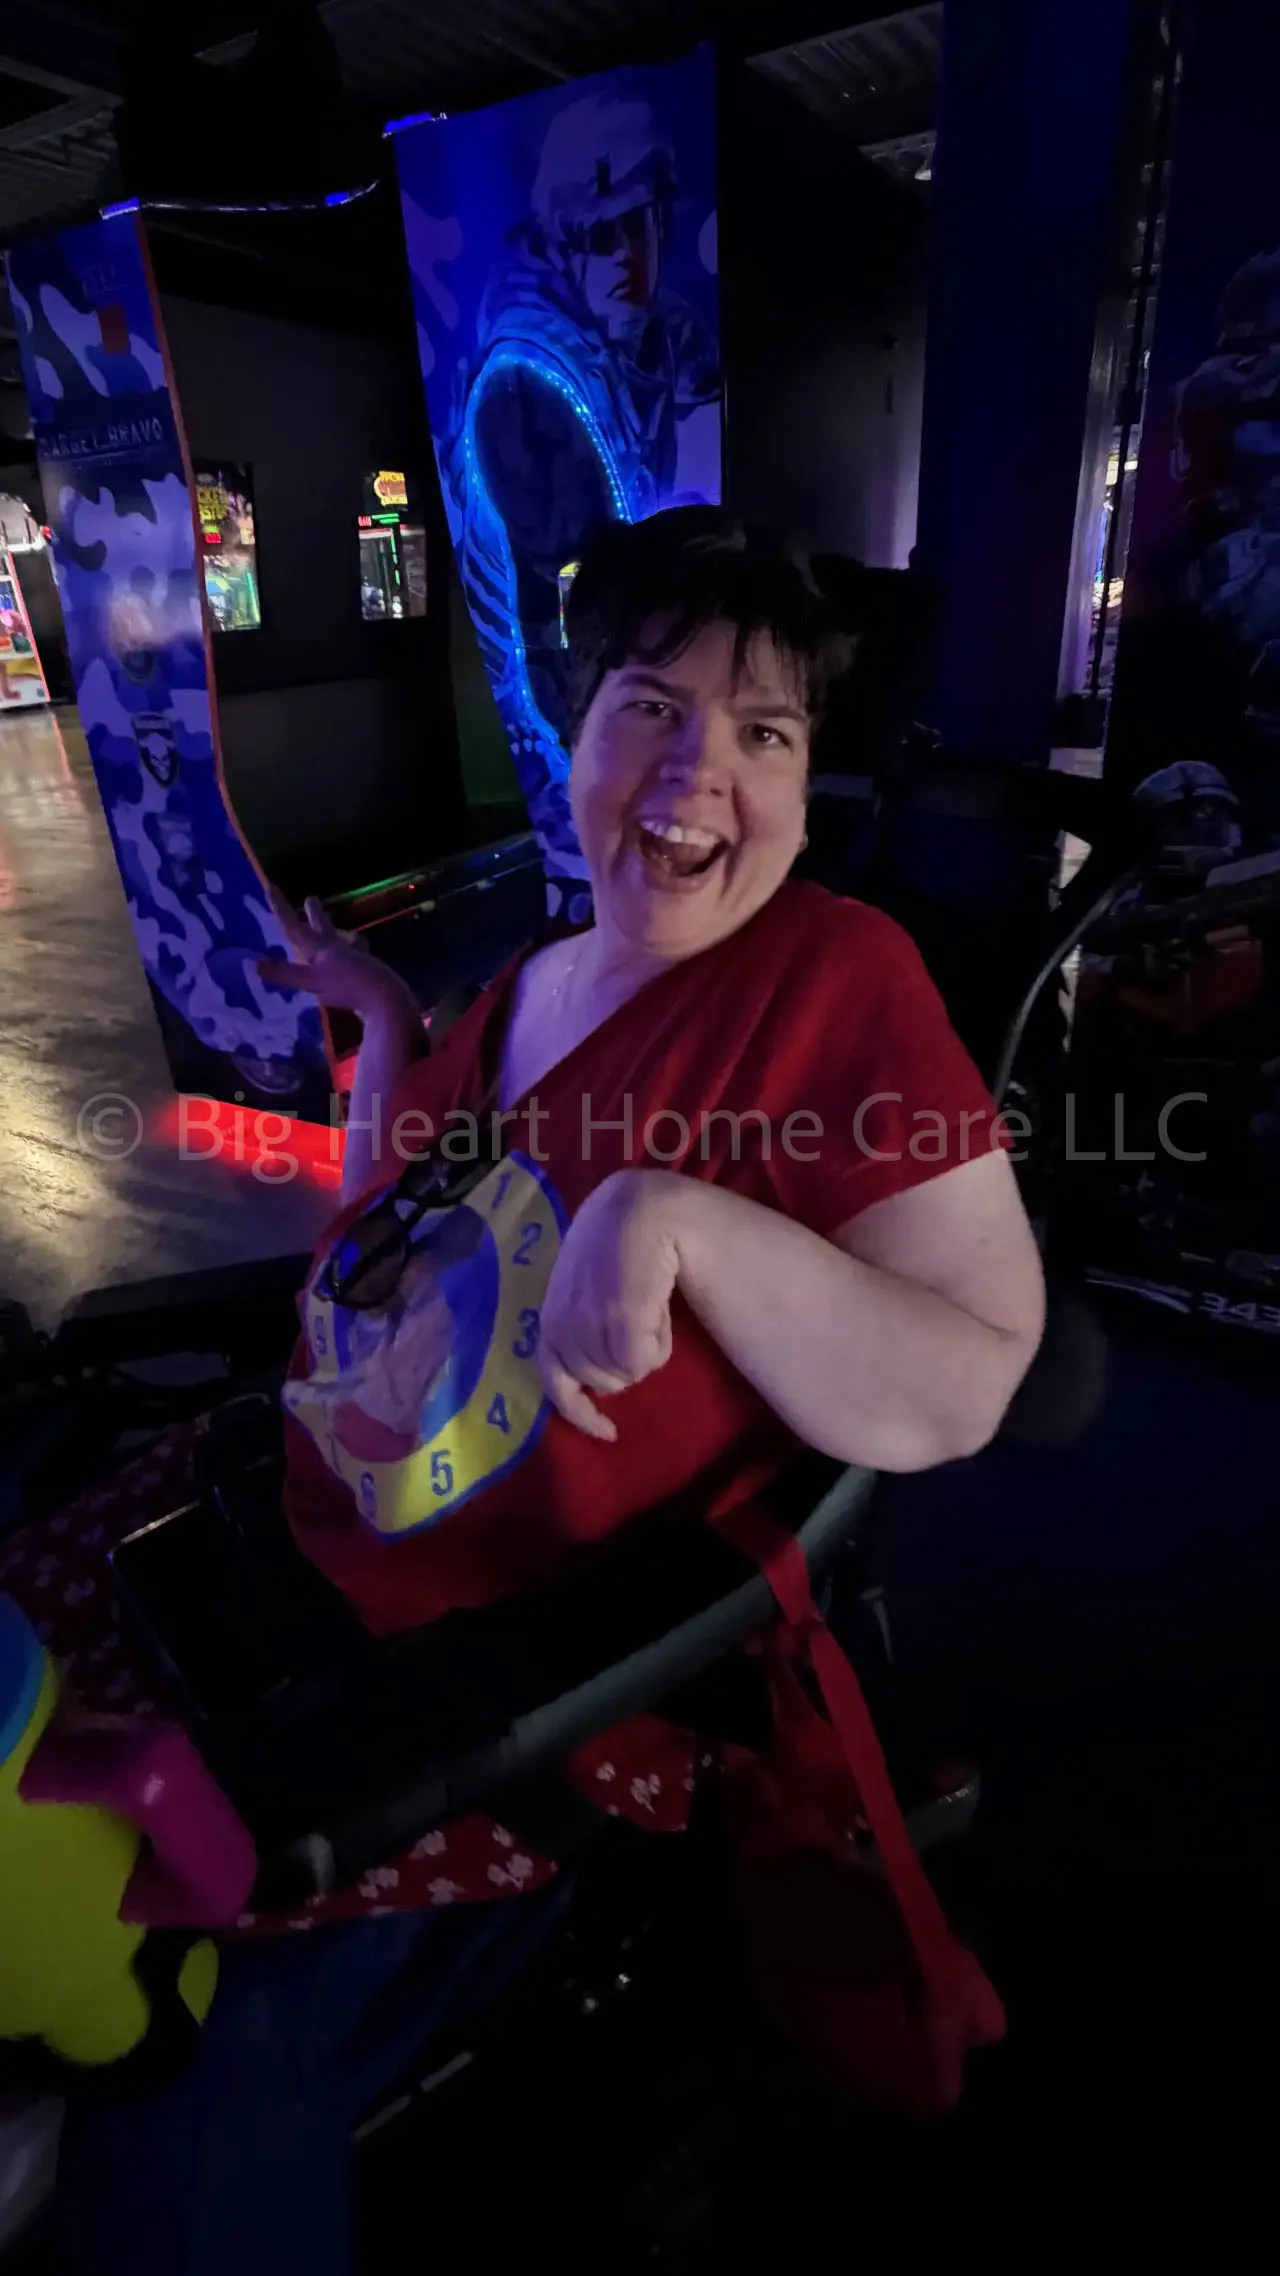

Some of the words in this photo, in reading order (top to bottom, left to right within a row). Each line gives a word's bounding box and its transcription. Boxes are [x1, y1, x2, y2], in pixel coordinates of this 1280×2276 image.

[513, 1222, 544, 1266] 2
[513, 1309, 541, 1359] 3
[486, 1392, 512, 1434] 4
[360, 1471, 378, 1519] 6
[429, 1448, 454, 1496] 5
